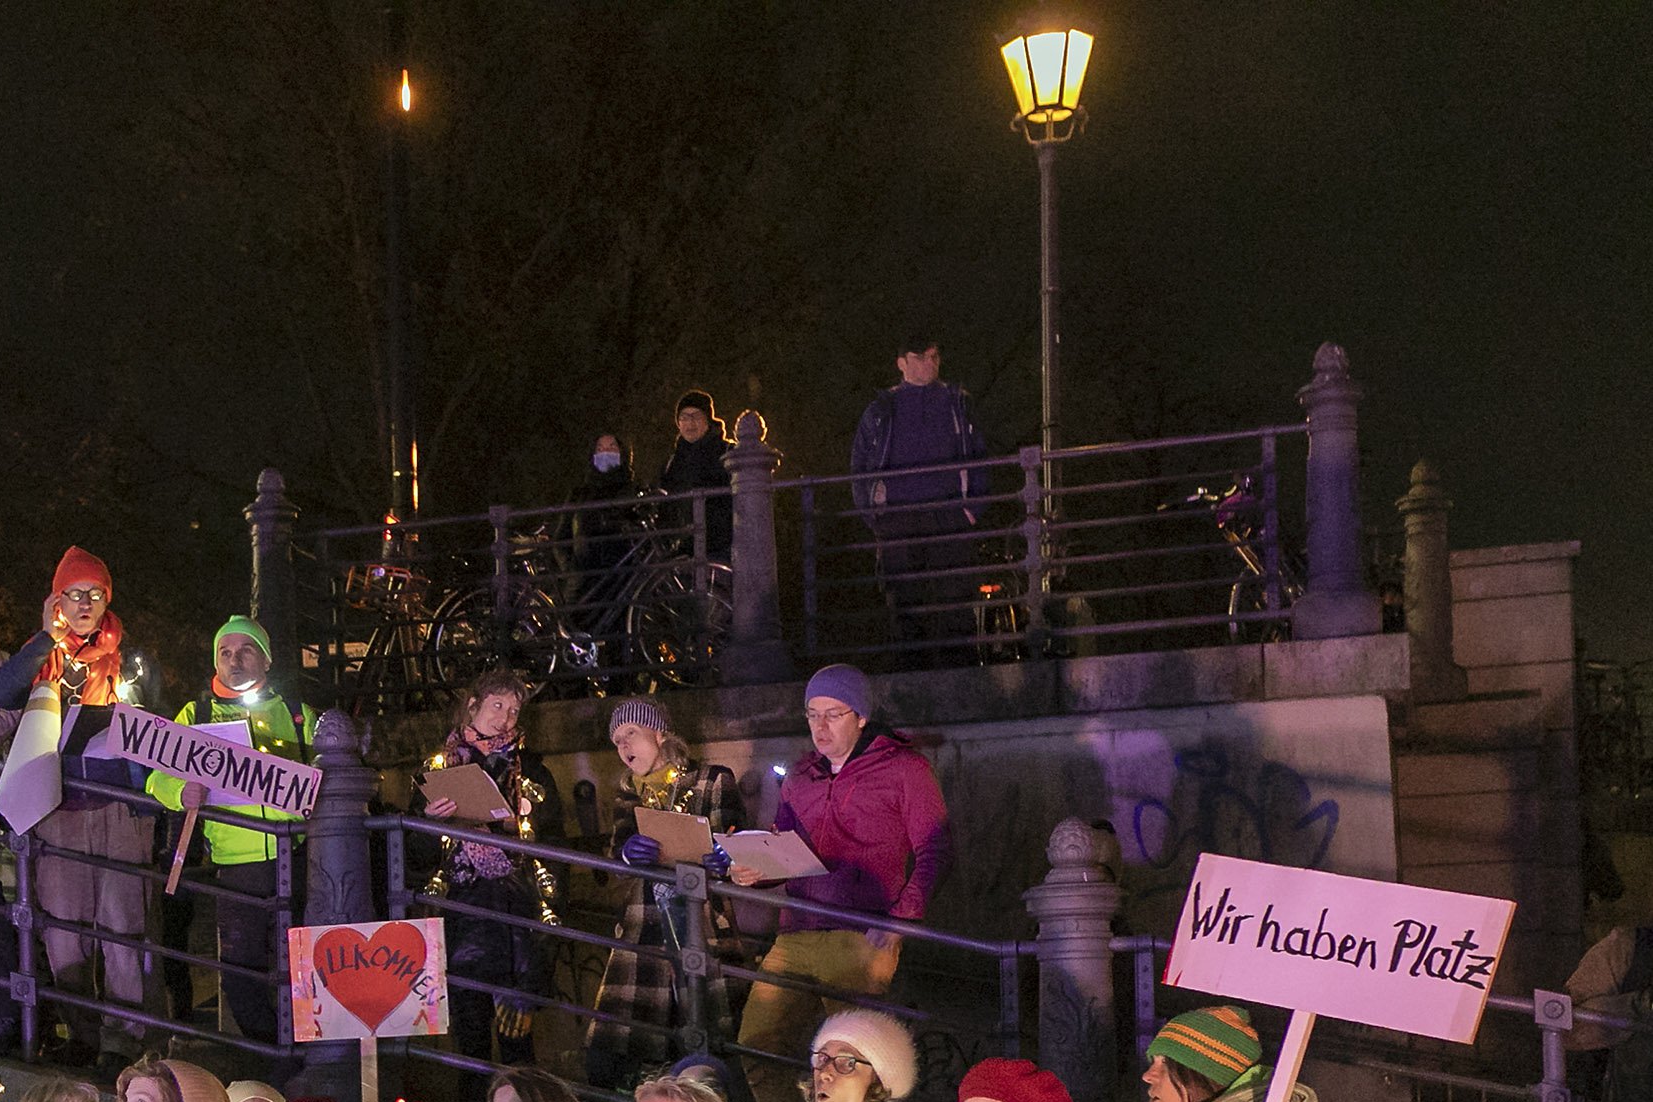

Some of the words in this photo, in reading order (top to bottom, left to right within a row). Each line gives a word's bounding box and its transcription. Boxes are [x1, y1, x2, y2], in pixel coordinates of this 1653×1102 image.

[1191, 881, 1254, 945] Wir
[1256, 904, 1376, 971] haben
[1387, 919, 1497, 990] Platz
